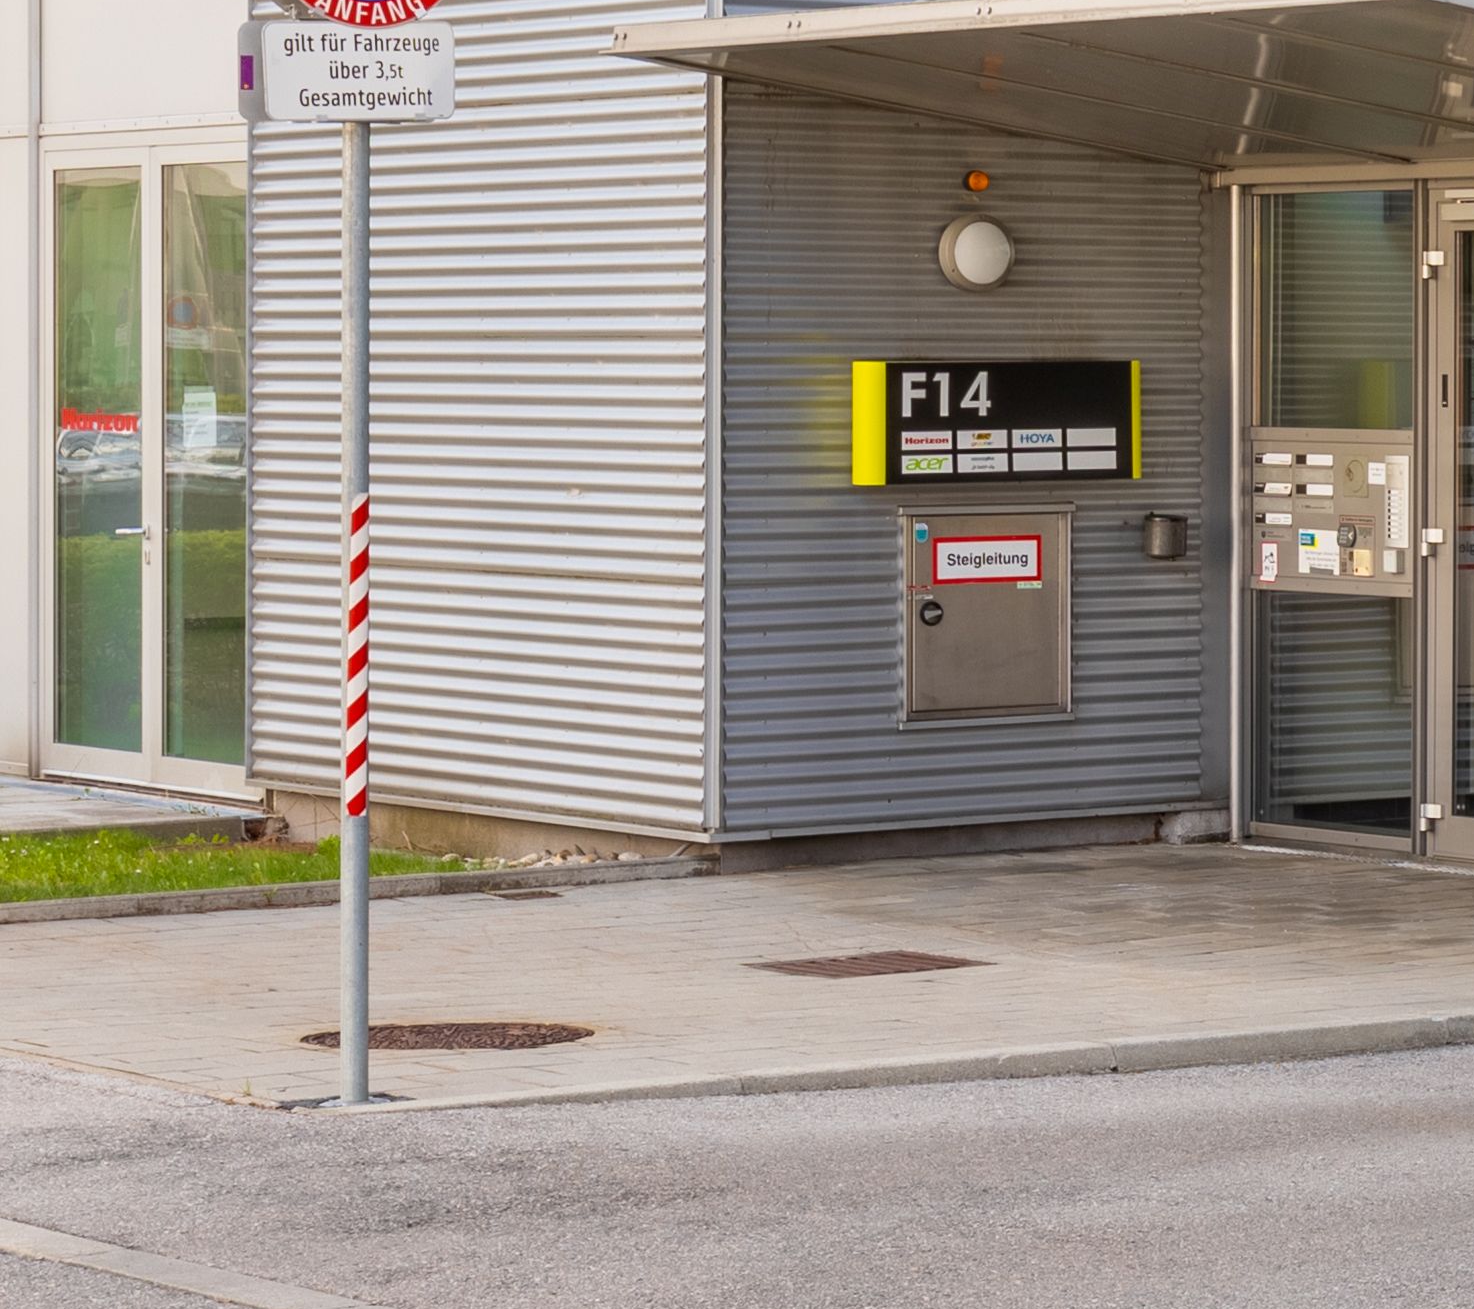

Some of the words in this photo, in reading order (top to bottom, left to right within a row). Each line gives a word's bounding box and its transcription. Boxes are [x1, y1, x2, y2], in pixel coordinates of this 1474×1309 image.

[283, 33, 314, 57] gilt
[320, 33, 347, 52] für
[353, 34, 440, 56] Fahrzeuge
[329, 61, 369, 81] über
[375, 60, 404, 81] 3,5t
[299, 87, 434, 110] Gesamtgewicht
[901, 371, 992, 417] F14
[61, 407, 139, 433] Horizon
[905, 436, 949, 445] Horizon
[1020, 433, 1055, 444] HOYA
[905, 457, 949, 471] acer
[946, 551, 1029, 569] Steigleitung
